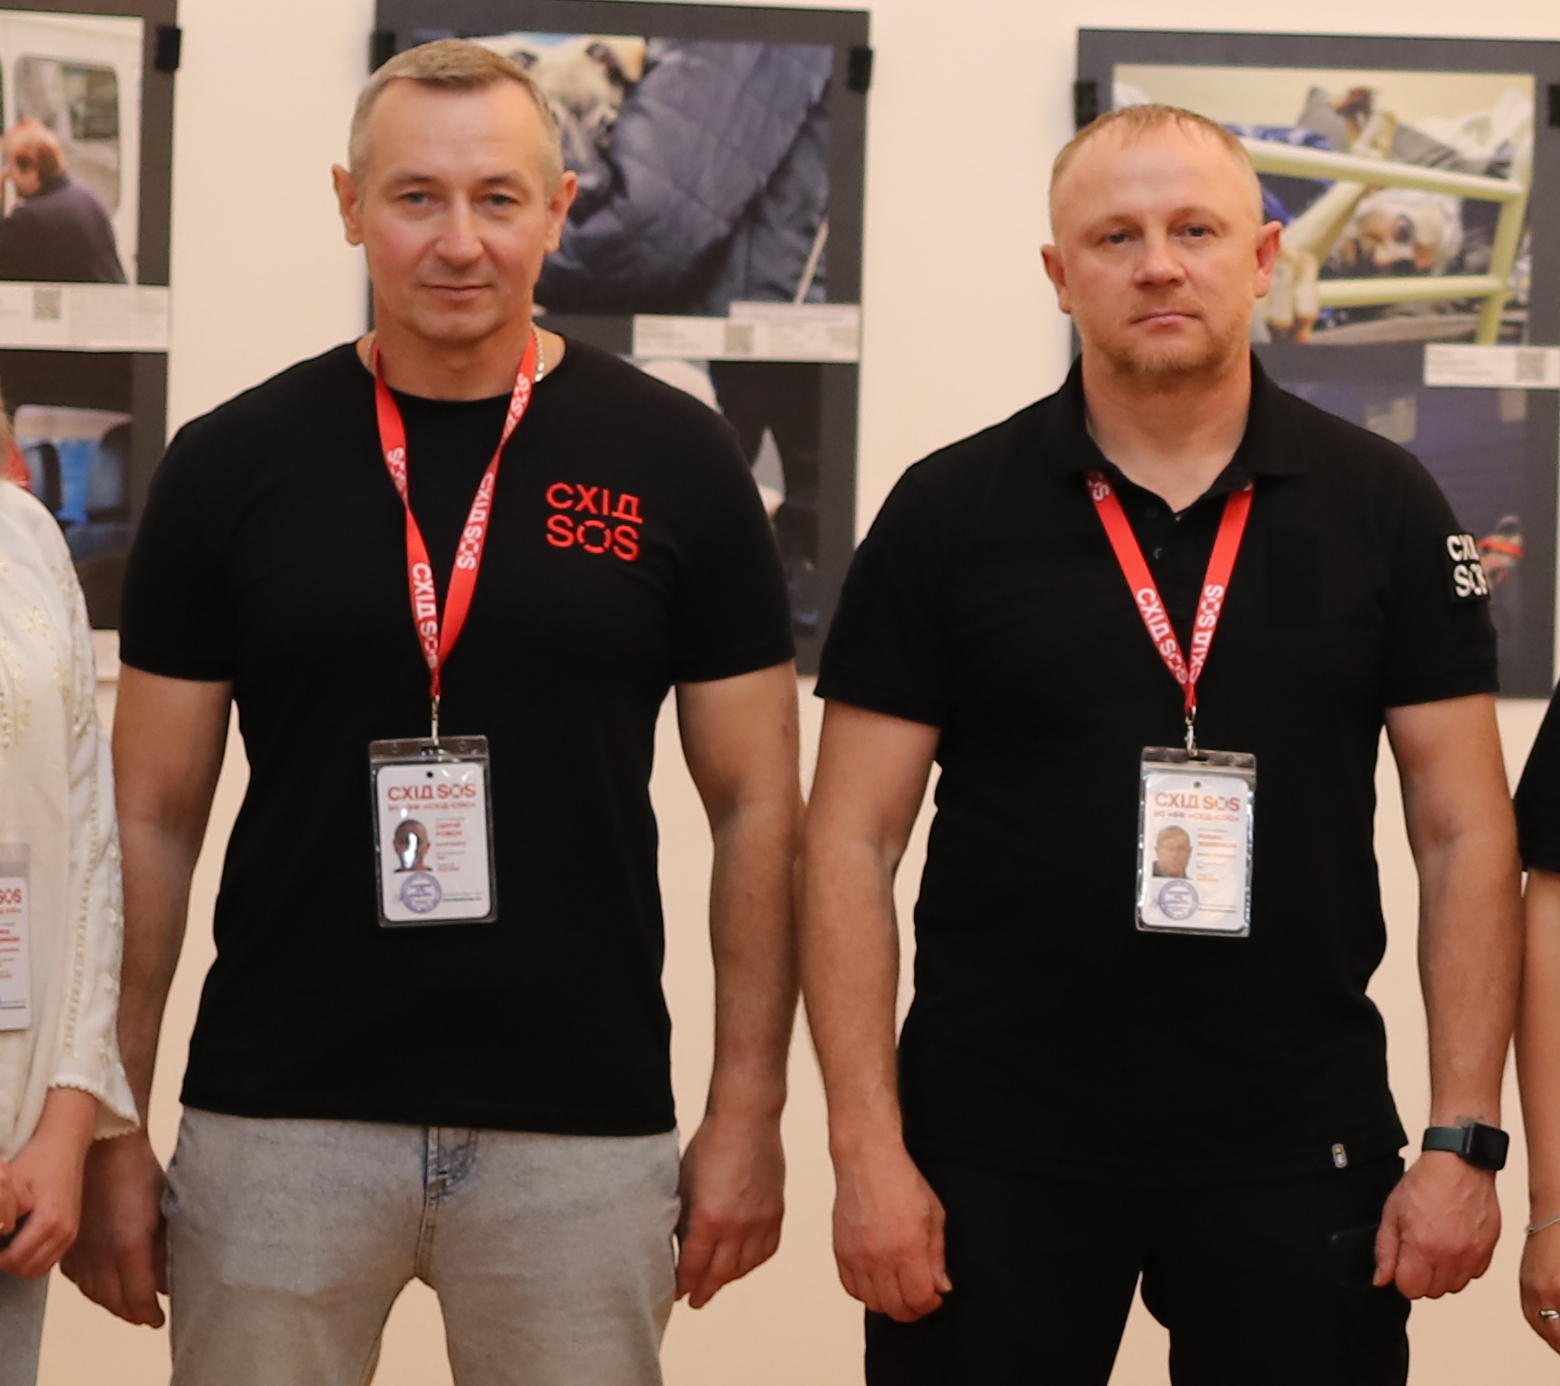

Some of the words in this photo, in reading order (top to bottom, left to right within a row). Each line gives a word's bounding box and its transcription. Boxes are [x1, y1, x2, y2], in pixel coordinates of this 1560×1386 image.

[468, 472, 495, 524] СХІД
[545, 483, 643, 524] СХІД
[456, 525, 484, 571] SOS
[546, 514, 640, 562] SOS
[412, 562, 438, 621] СХІД
[1197, 584, 1224, 628] SOS
[1136, 588, 1170, 641] СХІД
[1160, 638, 1189, 684] SOS
[1189, 628, 1213, 683] СХІД
[388, 785, 433, 801] СХІД
[437, 783, 476, 799] SOS
[1154, 792, 1200, 809] СХІД
[1203, 795, 1241, 812] SOS
